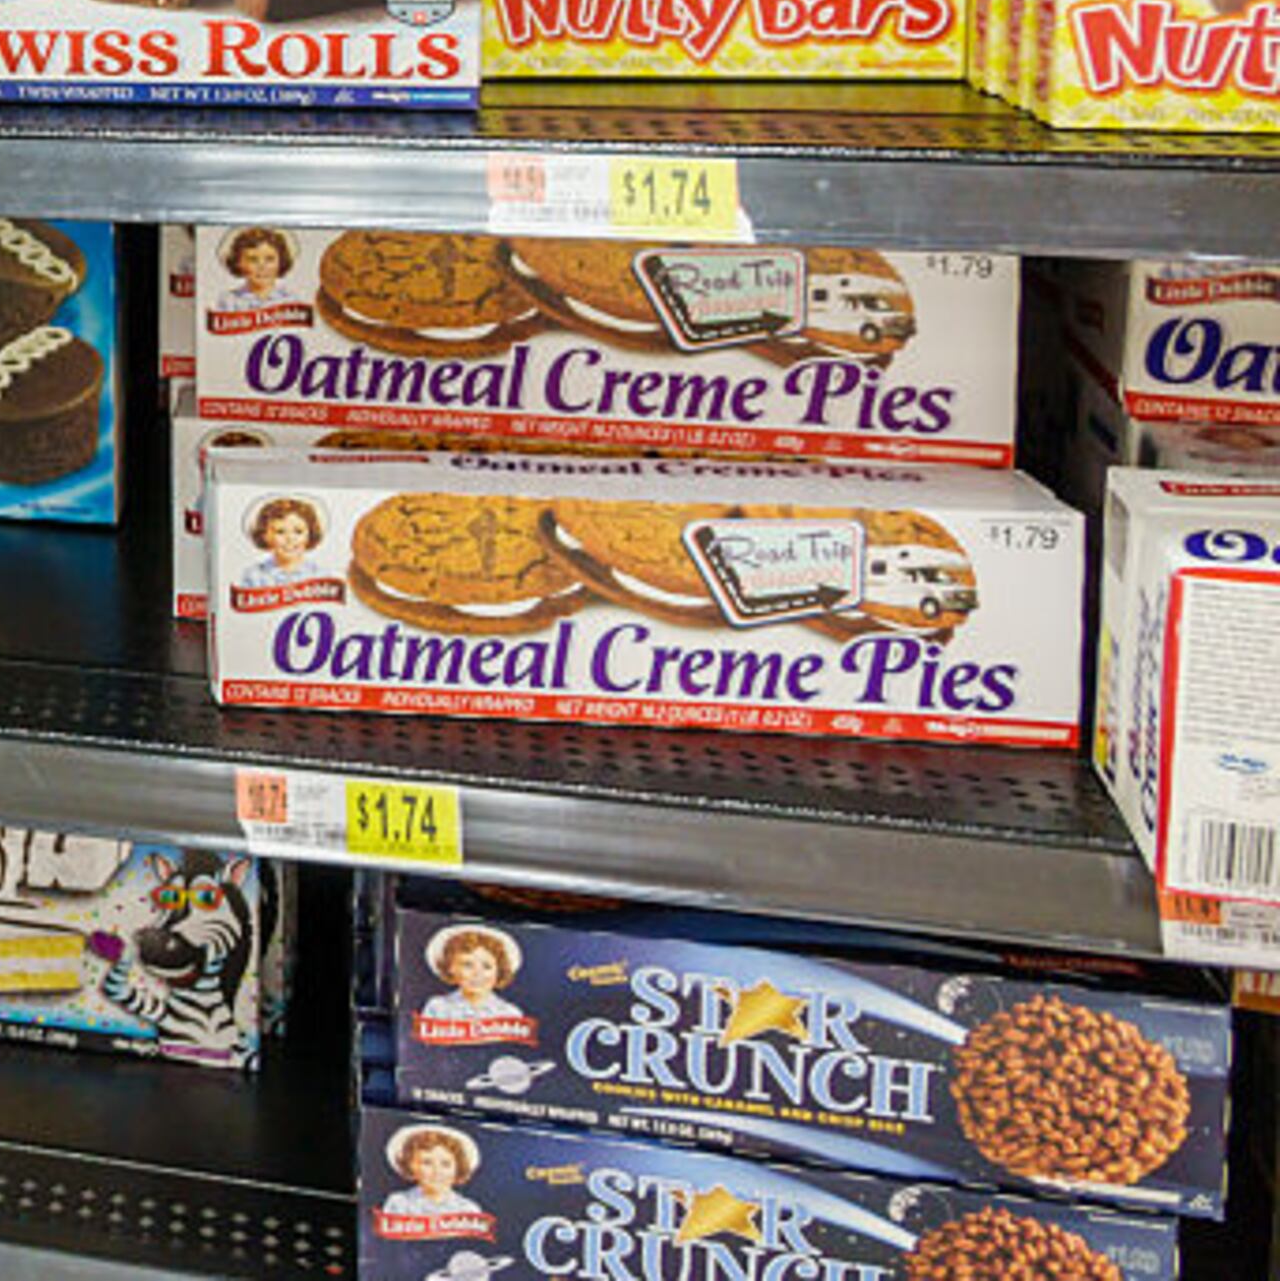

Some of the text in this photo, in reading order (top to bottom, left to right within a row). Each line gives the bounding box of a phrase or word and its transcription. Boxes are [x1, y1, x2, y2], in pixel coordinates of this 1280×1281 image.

[202, 20, 462, 81] ROLLS
[621, 169, 712, 217] $1.74
[926, 255, 996, 280] $1.79
[245, 335, 956, 436] Oatmeal Creme Pies
[991, 525, 1059, 551] $1.79
[236, 580, 343, 610] Little Debbie
[273, 609, 1018, 713] Oatmeal Creme Pies
[357, 792, 437, 845] $1.74
[419, 1018, 532, 1040] Little Debbie
[565, 1018, 936, 1124] CRUNCH
